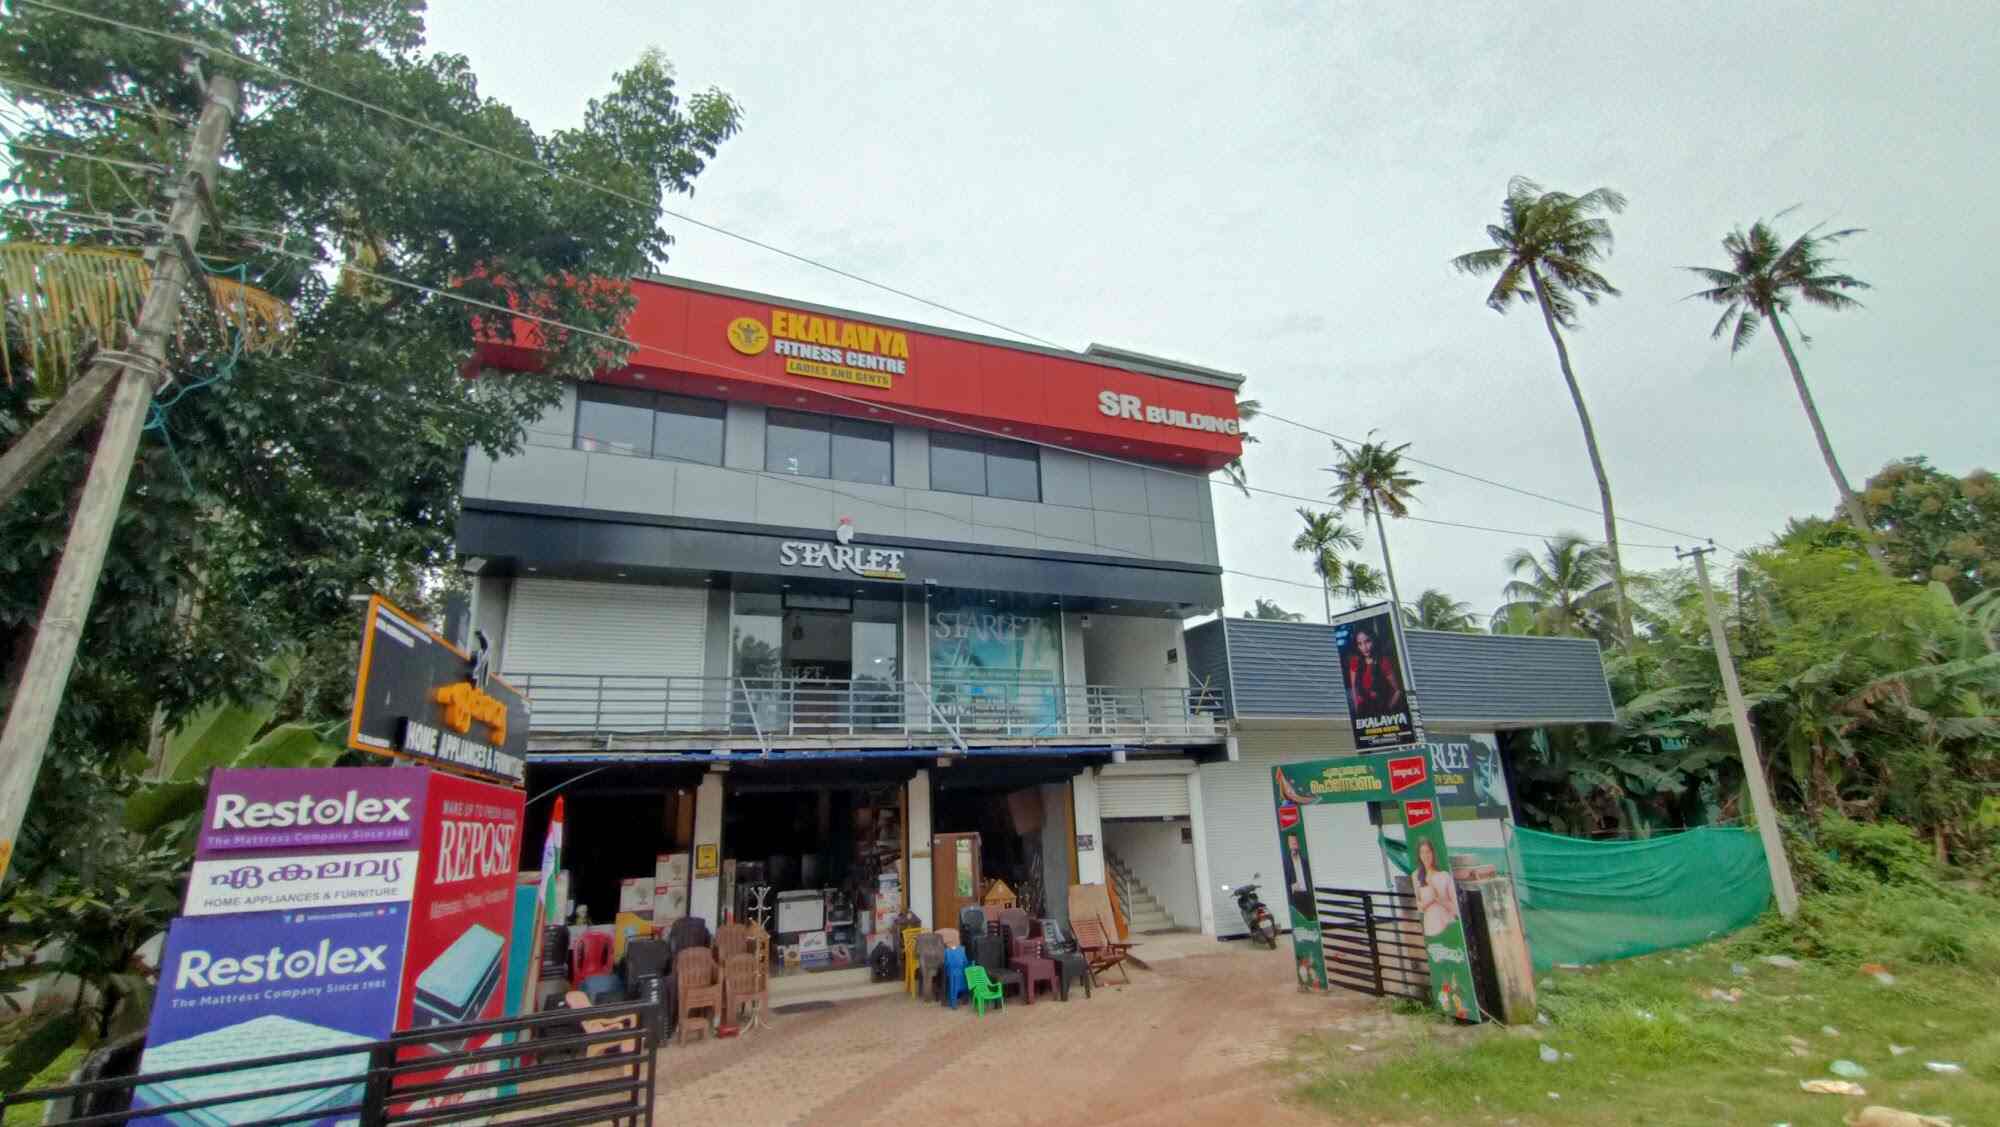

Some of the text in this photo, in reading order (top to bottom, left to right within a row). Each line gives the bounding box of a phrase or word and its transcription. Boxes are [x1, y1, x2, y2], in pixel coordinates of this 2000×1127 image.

[771, 310, 909, 359] EKALAVYA
[774, 339, 907, 375] FITNESS CENTRE
[789, 361, 890, 386] LADIES AND GENTS
[1098, 390, 1240, 435] SR BUILDING
[780, 541, 905, 576] STARLET
[405, 719, 440, 756] HOME
[212, 789, 412, 830] Restolex
[207, 835, 233, 847] The
[234, 831, 290, 845] Mattress
[294, 829, 350, 843] Company
[352, 828, 385, 841] Since
[434, 820, 515, 884] REPOSE
[203, 886, 399, 909] HOME APPLIANCES & FURNITURE
[175, 937, 389, 990] Restolex
[172, 998, 197, 1009] The
[200, 992, 261, 1007] Mattress
[264, 985, 323, 1001] Company
[326, 981, 360, 993] Since
